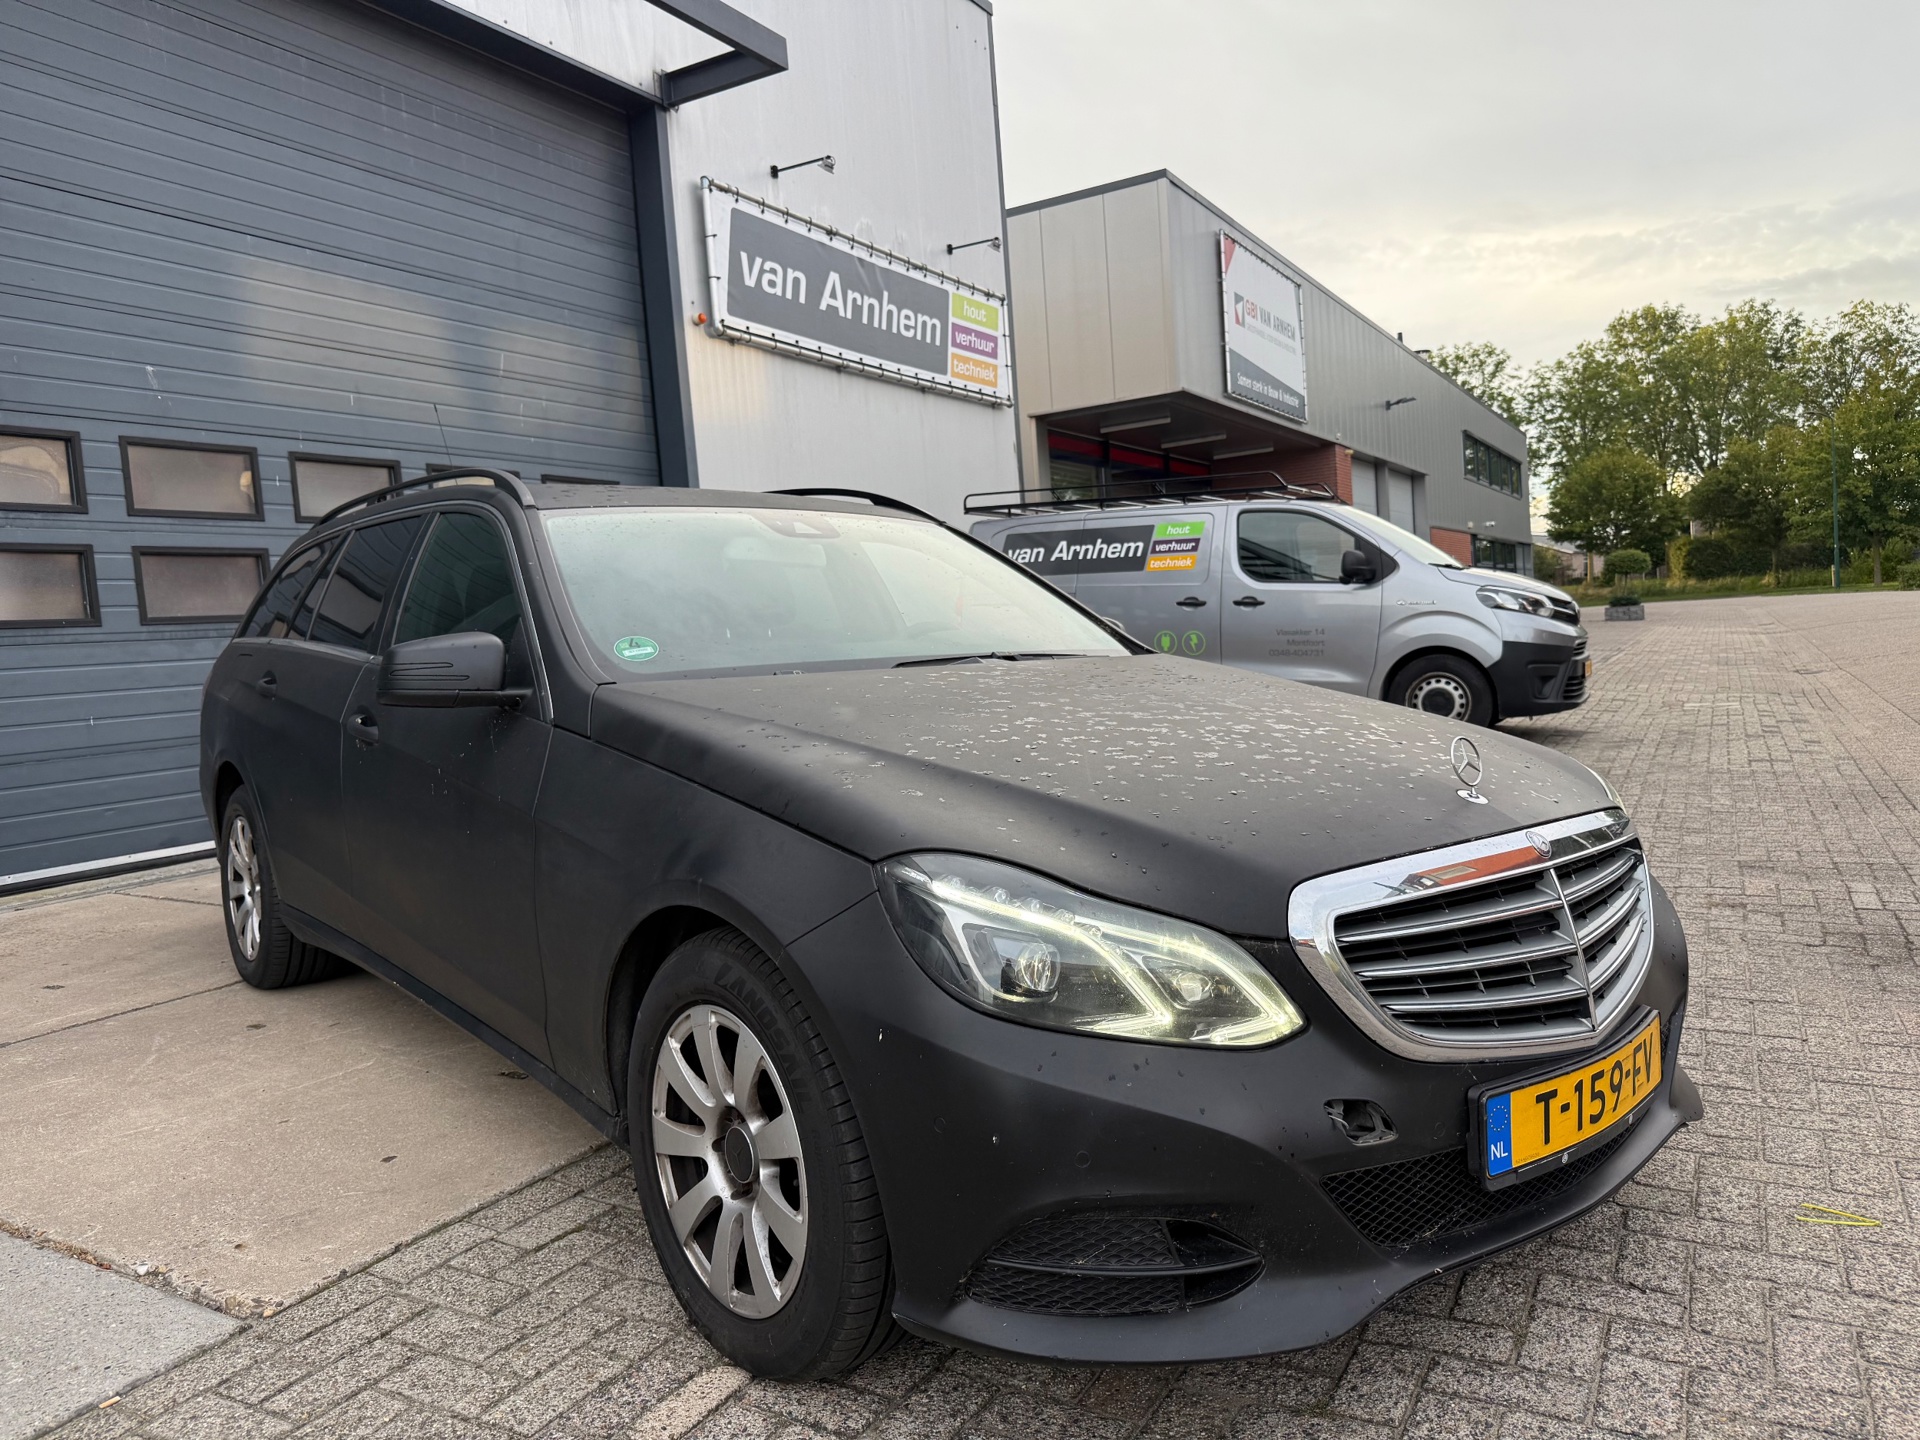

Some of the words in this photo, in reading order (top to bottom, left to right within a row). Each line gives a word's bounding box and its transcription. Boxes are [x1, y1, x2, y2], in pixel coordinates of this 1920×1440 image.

[740, 251, 807, 304] van
[819, 271, 941, 346] Arnhem
[963, 302, 986, 322] hout
[1245, 299, 1258, 322] GBI
[1259, 305, 1271, 329] VAN
[1273, 314, 1296, 343] ARNHEM
[955, 330, 994, 354] verhuur
[953, 358, 995, 382] techniek
[1237, 371, 1252, 389] Samen
[1166, 525, 1190, 535] hout
[1007, 547, 1045, 564] van
[1050, 538, 1144, 562] Arnhem
[1155, 541, 1196, 552] verhuur
[1150, 557, 1193, 568] techniek
[1315, 628, 1325, 637] 14
[1535, 1031, 1653, 1146] T-159-FV
[1490, 1141, 1508, 1161] NL
